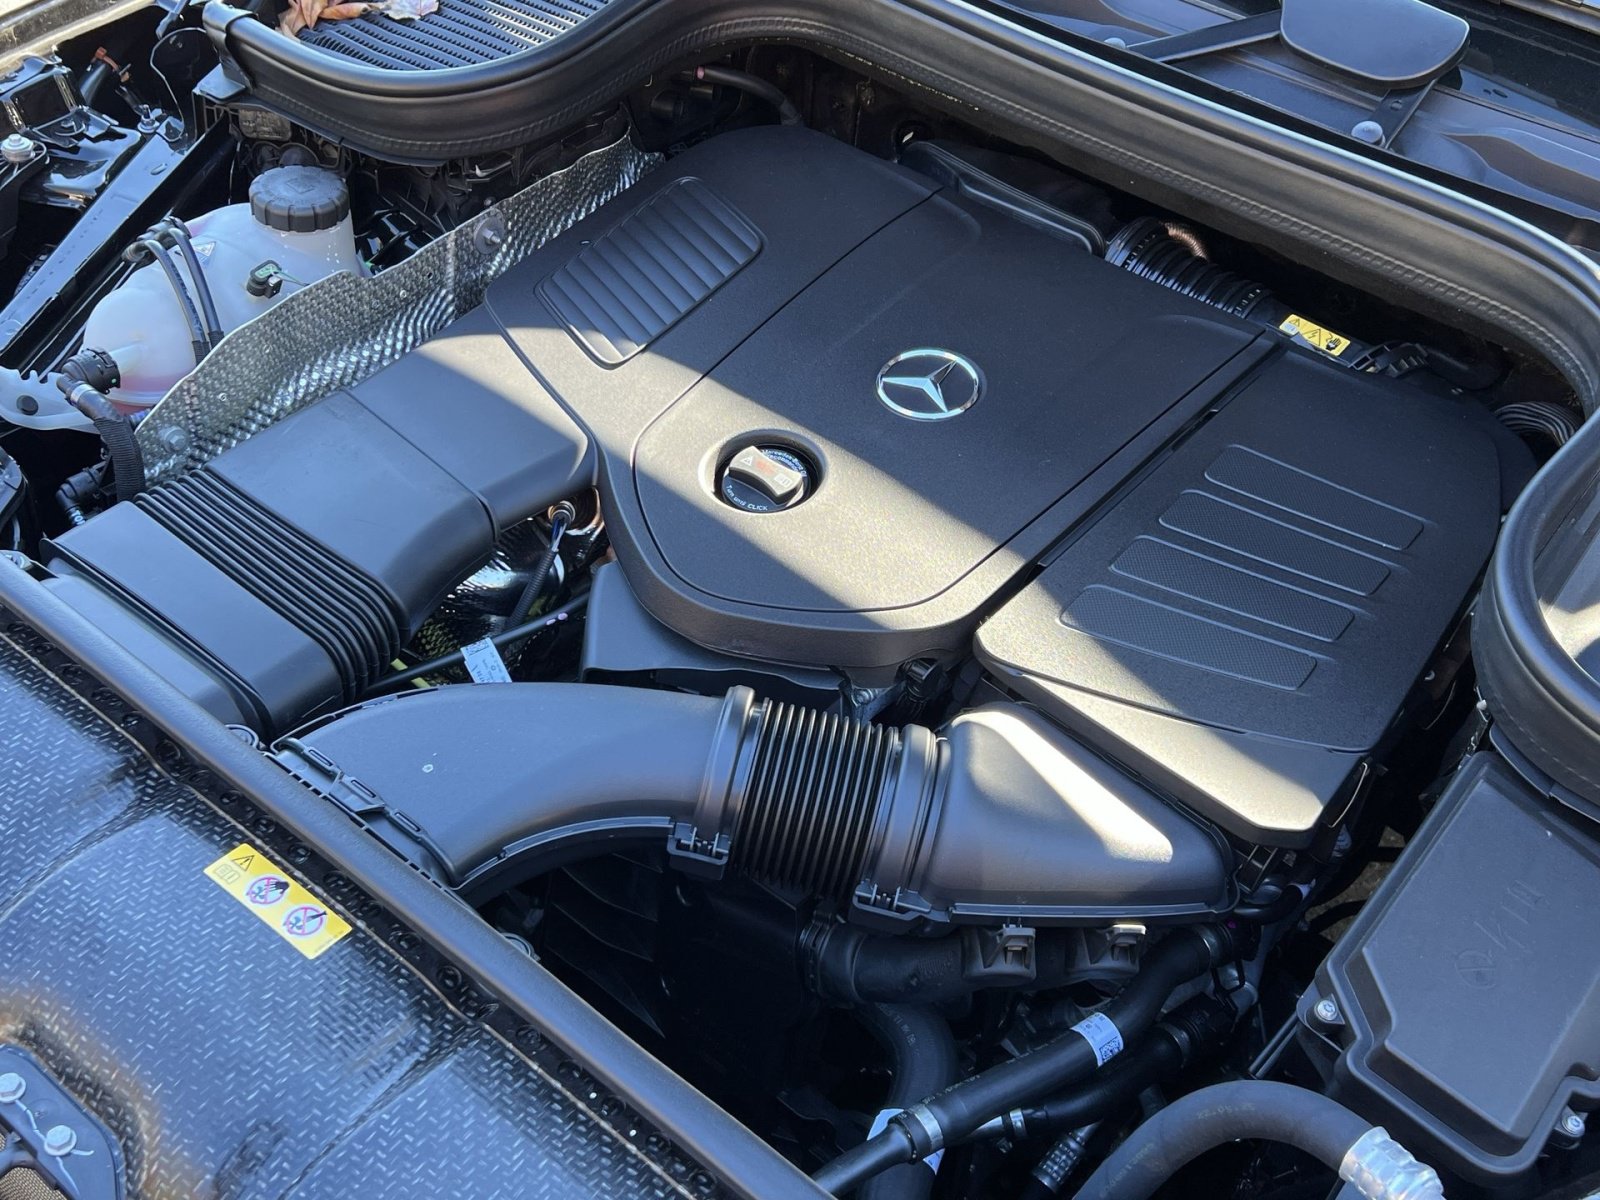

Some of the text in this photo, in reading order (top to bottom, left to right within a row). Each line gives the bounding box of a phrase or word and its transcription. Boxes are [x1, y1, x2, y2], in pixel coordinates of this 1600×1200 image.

[726, 484, 768, 511] Turn until CLICK
